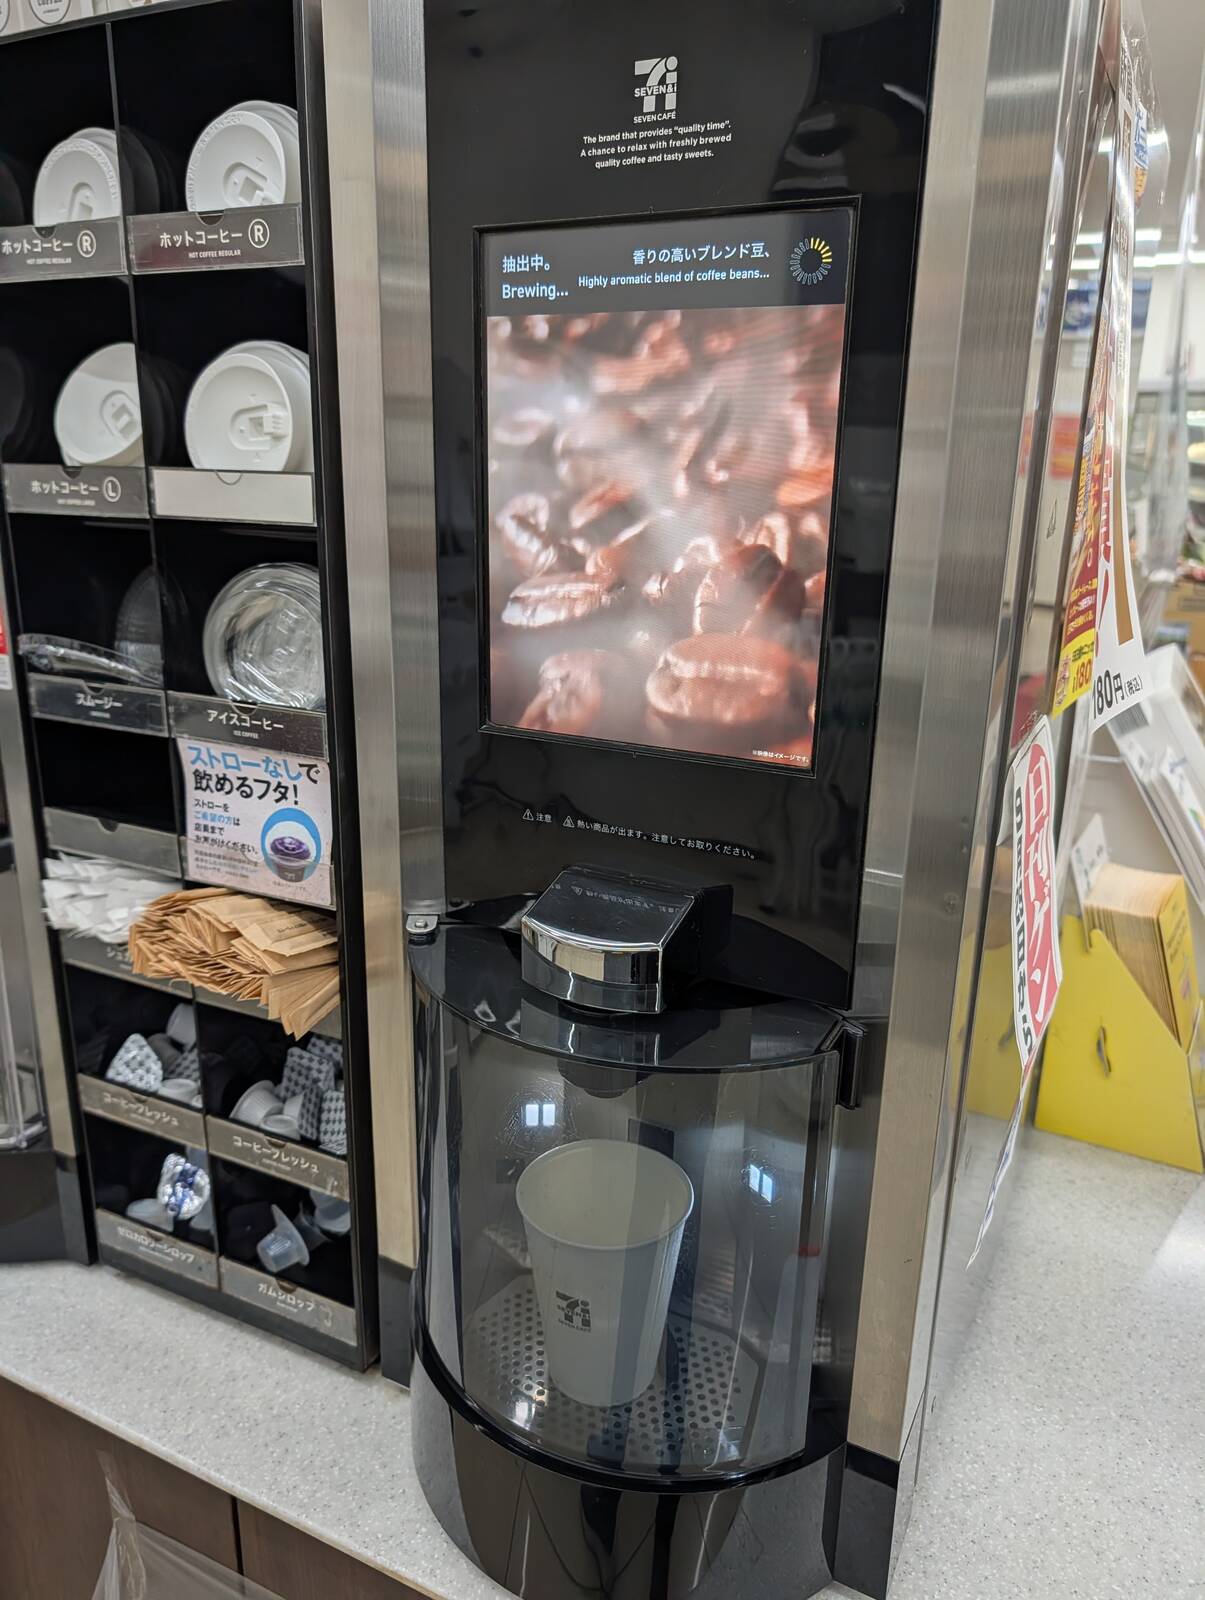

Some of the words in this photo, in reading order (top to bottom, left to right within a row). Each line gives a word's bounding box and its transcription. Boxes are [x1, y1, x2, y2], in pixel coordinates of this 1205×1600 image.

[633, 114, 656, 123] SEVEN
[657, 110, 676, 120] CAFÉ
[583, 136, 597, 144] The
[599, 132, 620, 142] brand
[622, 131, 637, 140] that
[639, 128, 672, 139] provides
[674, 124, 705, 134] “quality
[580, 149, 586, 157] A
[587, 147, 615, 156] chance
[627, 143, 647, 152] relax
[649, 141, 667, 149] with
[669, 137, 698, 147] freshly
[699, 133, 732, 144] brewed
[595, 159, 620, 169] quality
[622, 156, 646, 165] coffee
[648, 153, 662, 162] and
[664, 152, 683, 161] tasty
[685, 150, 714, 159] sweets.
[2, 239, 72, 255] ホットコーヒー
[160, 229, 242, 248] ホットコーヒー
[503, 254, 550, 273] 抽出中。
[633, 242, 770, 265] 香りの高いブレンド豆、
[579, 275, 608, 289] Highly
[611, 272, 652, 285] aromatic
[655, 271, 681, 283] blend
[684, 270, 694, 282] of
[696, 269, 726, 281] coffee
[730, 268, 770, 279] beans...
[502, 283, 569, 300] Brewing...
[32, 480, 99, 495] ホットコーヒー
[207, 709, 284, 730] アイスコーヒー
[188, 746, 320, 784] ストローなしで
[193, 768, 298, 805] 飲めるフタ!
[194, 799, 229, 812] ストローを
[536, 812, 552, 823] 注意
[103, 1092, 178, 1125] コーヒーフレッシュ
[233, 1135, 319, 1173] コーヒーフレッシュ
[258, 1283, 315, 1311] ガムシロップ
